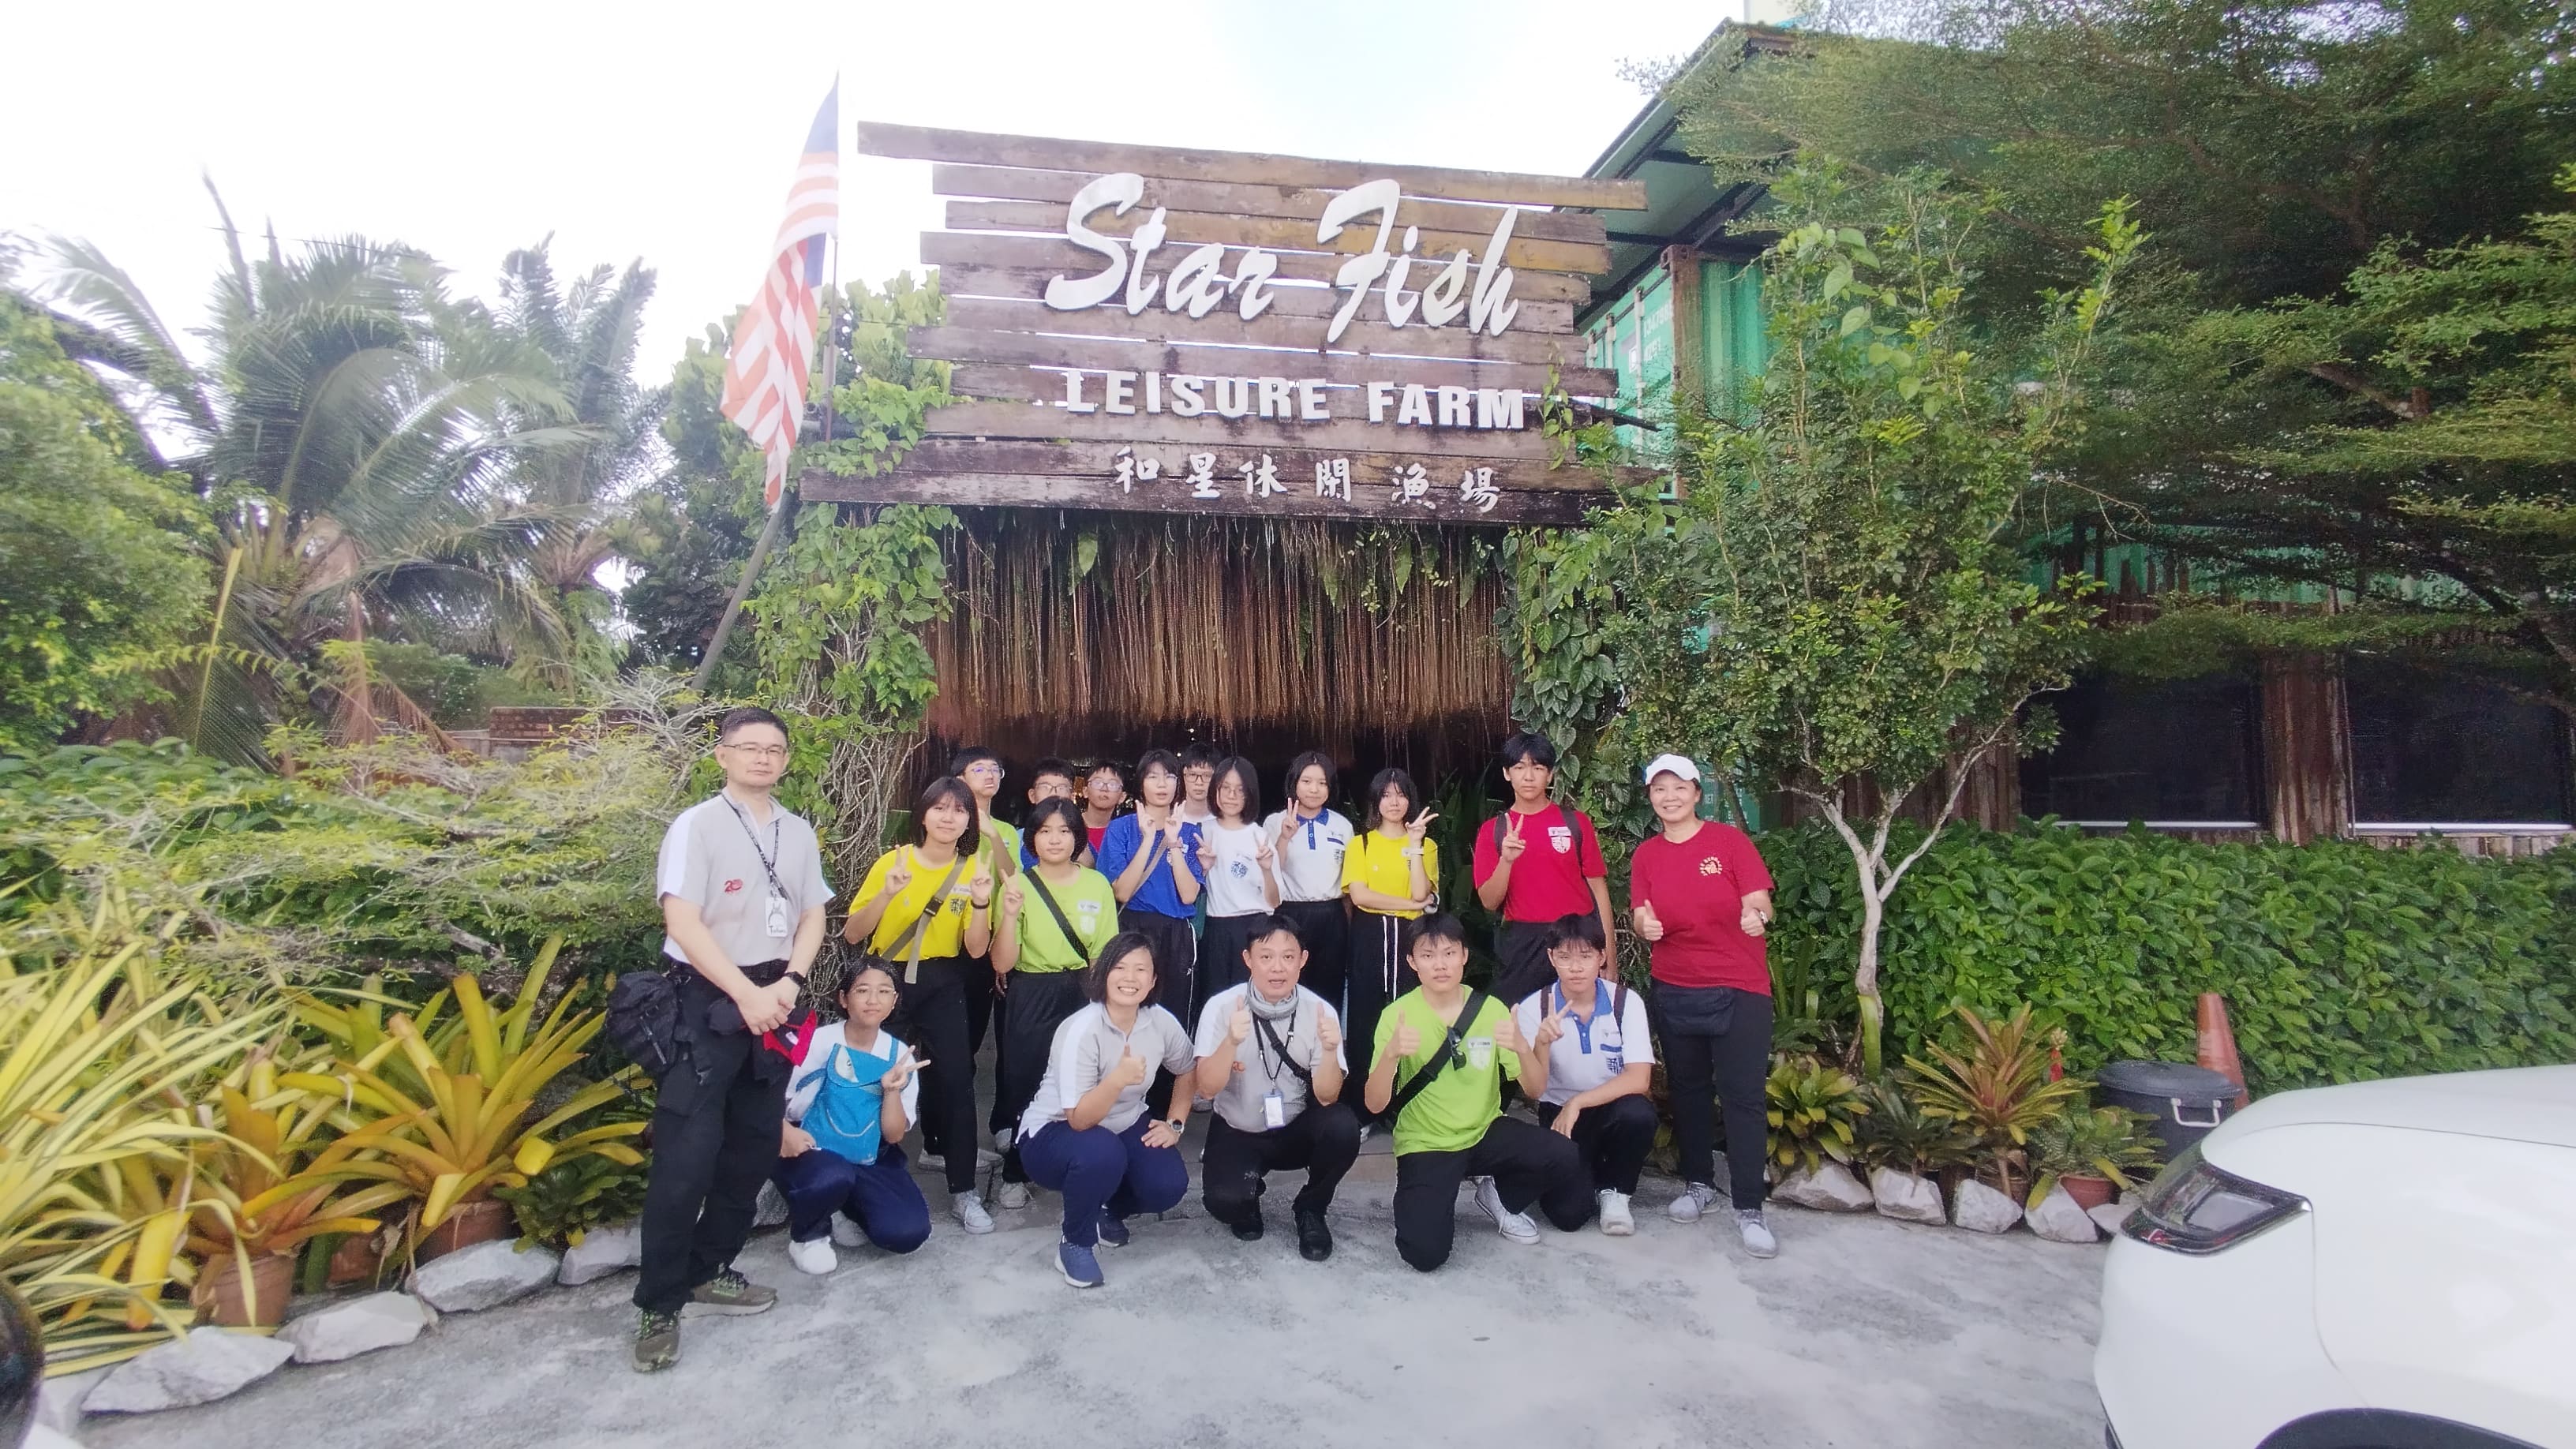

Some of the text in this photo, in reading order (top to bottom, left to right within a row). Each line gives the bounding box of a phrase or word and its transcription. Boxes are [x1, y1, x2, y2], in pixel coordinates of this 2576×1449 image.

[1044, 172, 1519, 343] Star Fish
[1067, 370, 1524, 429] LEISURE FARM
